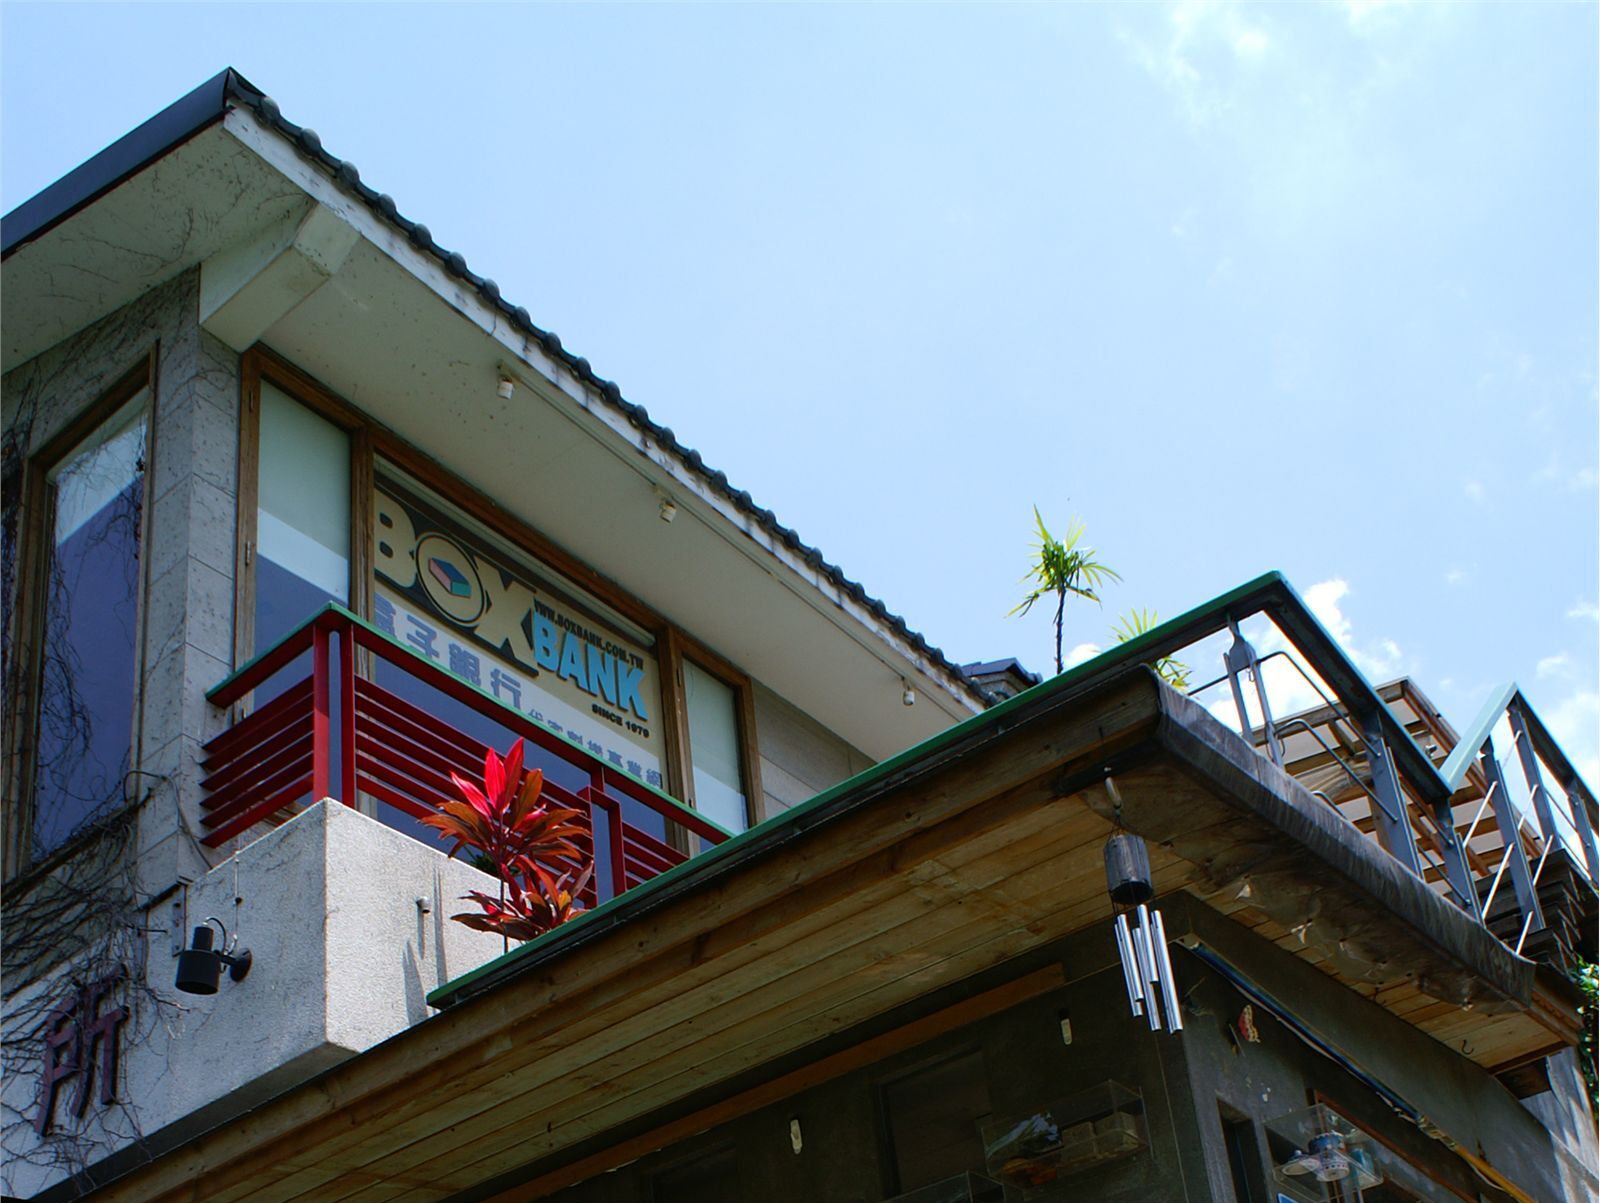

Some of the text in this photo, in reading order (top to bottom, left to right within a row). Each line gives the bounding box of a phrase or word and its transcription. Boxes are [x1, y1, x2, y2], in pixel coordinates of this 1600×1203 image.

[374, 487, 538, 675] BOX
[534, 610, 650, 722] BANK
[592, 703, 650, 739] SINCE 1979
